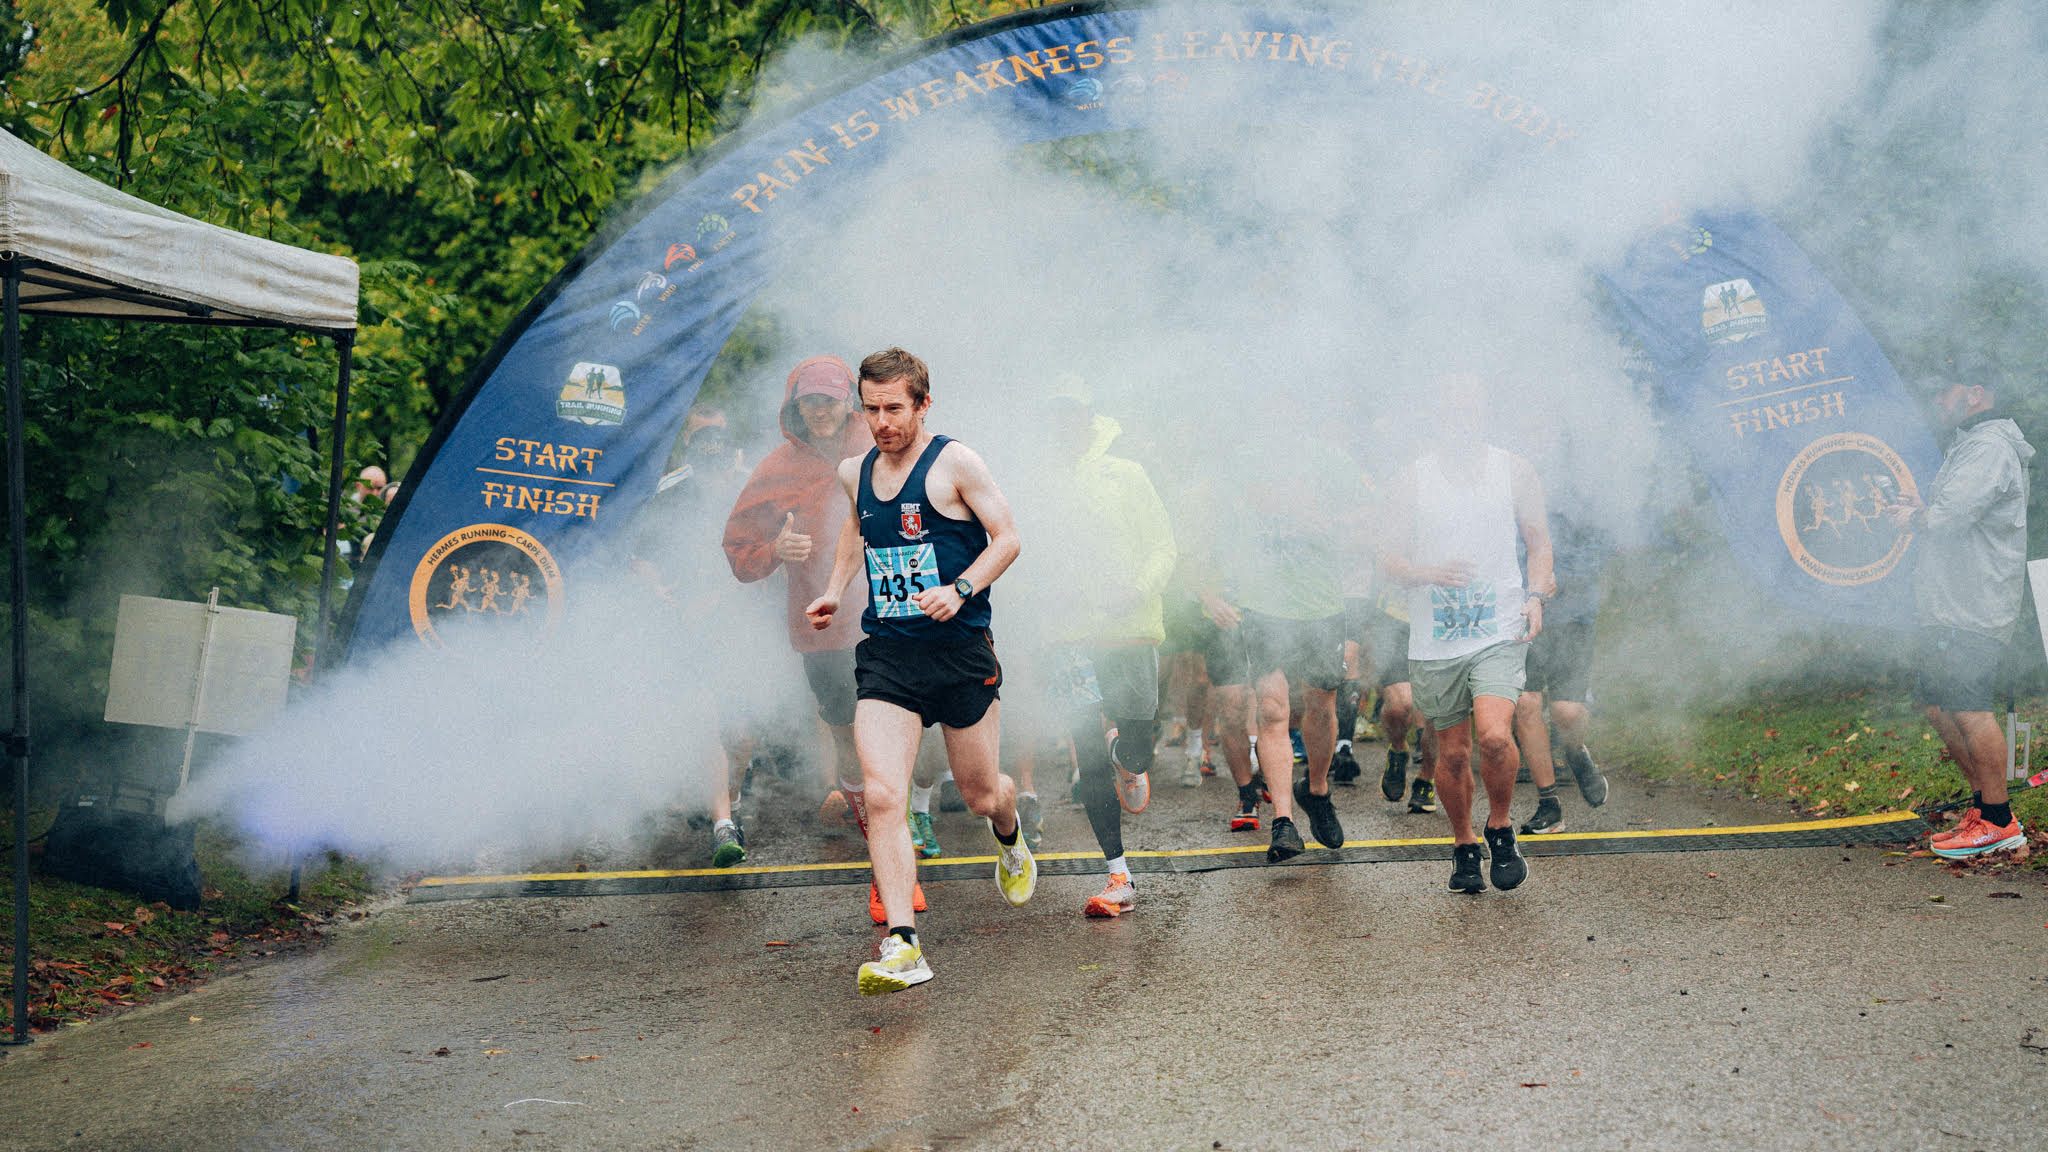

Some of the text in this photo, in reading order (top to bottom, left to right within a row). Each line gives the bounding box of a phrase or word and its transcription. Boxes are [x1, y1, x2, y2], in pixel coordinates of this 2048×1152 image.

[731, 138, 831, 213] PAIN
[830, 110, 880, 150] IS
[880, 36, 1136, 122] WEAKNESS
[1151, 31, 1354, 71] LEAVING
[1466, 80, 1581, 151] BODY
[1726, 347, 1830, 391] START
[560, 401, 584, 409] TRAIL
[586, 402, 623, 416] RUNNING
[1730, 392, 1845, 439] FINISH
[495, 437, 603, 475] START
[481, 482, 602, 520] FINISH
[427, 536, 459, 566] HERMES
[461, 529, 507, 541] RUNNING
[516, 536, 542, 557] CARPE
[880, 572, 925, 602] 435
[1443, 604, 1484, 629] 357
